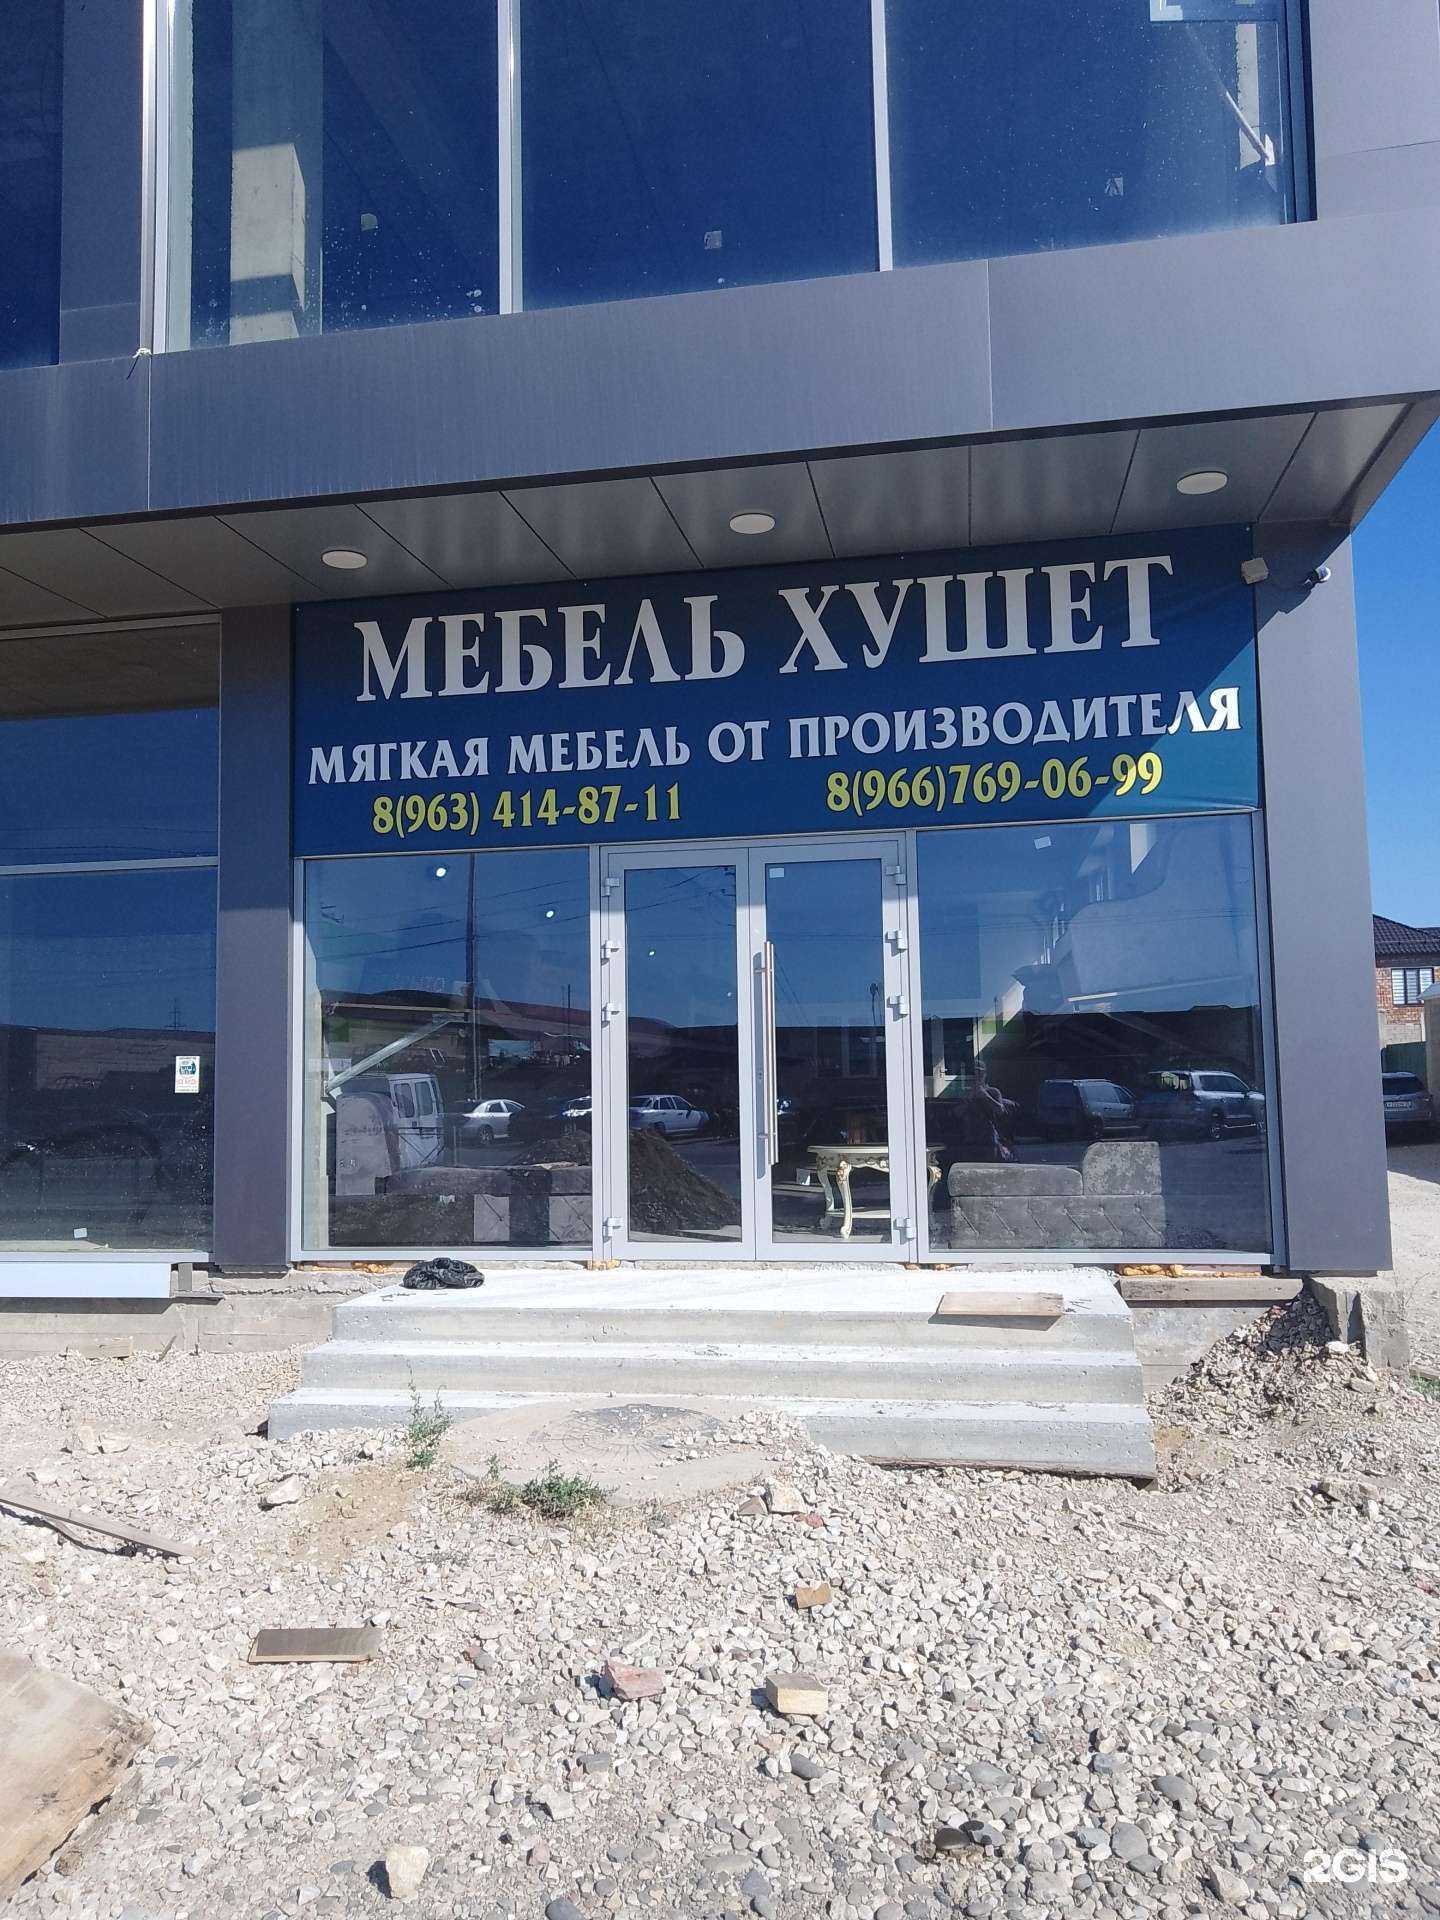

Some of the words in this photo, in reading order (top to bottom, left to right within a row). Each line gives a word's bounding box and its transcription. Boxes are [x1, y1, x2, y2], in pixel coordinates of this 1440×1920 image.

[354, 595, 745, 702] МЕБЕЛЬ
[778, 555, 1174, 674] ХУШЕТ
[308, 737, 489, 785] МЯГКАЯ
[507, 726, 690, 775] МЕБЕЛЬ
[708, 720, 769, 764] ОТ
[789, 686, 1241, 759] ПРОИЗВОДИТЕЛЯ
[372, 791, 480, 839] 8(963)
[492, 782, 682, 829] 414-87-11
[826, 752, 1163, 817] 8(966)769-06-99
